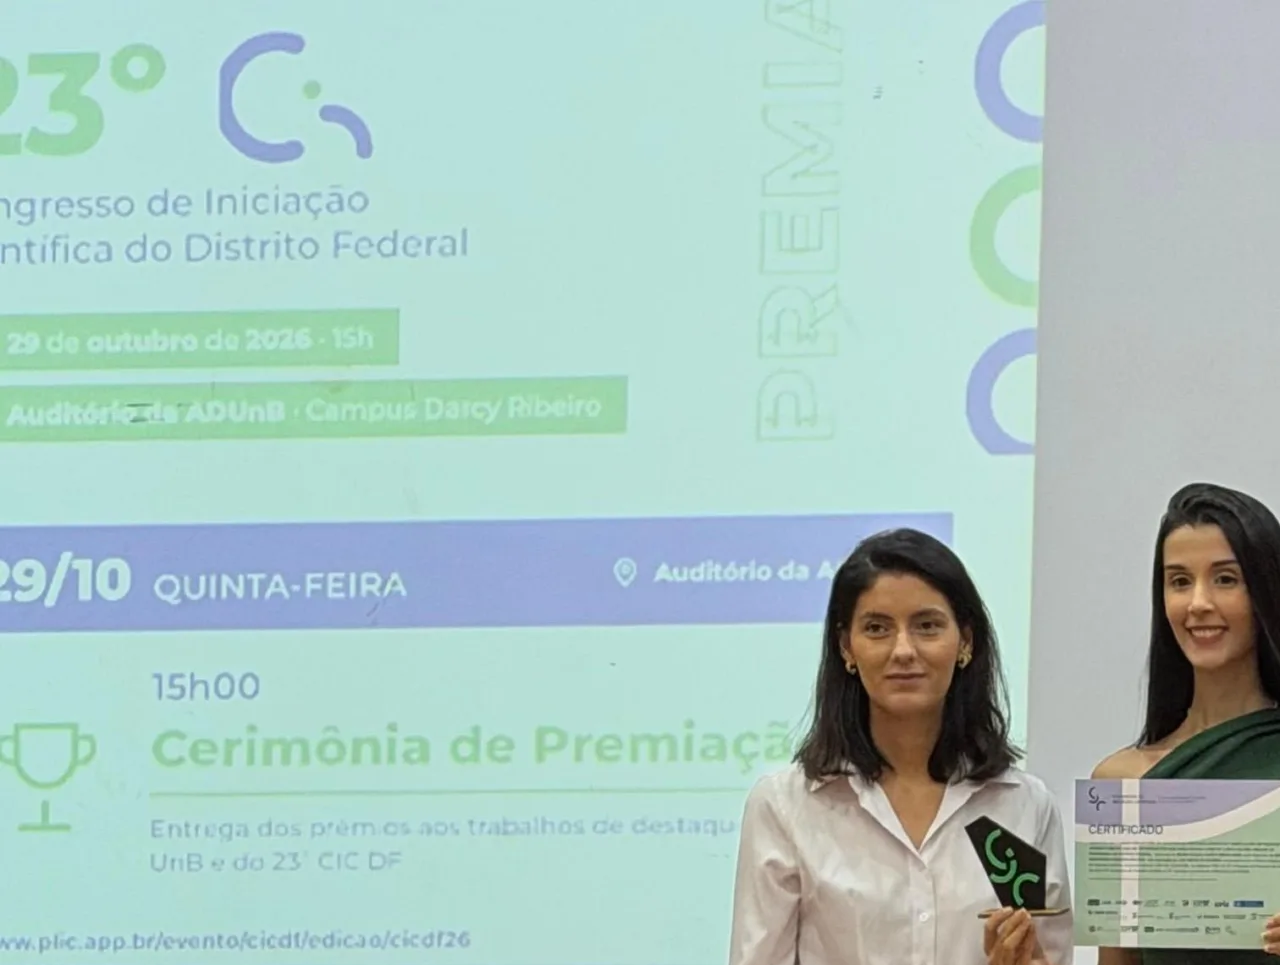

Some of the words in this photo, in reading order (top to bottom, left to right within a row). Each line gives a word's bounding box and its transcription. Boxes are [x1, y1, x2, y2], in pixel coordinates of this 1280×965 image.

[147, 188, 193, 217] de
[205, 185, 370, 219] Iniciação
[125, 234, 172, 262] do
[185, 232, 320, 261] Distrito
[333, 228, 468, 259] Federal
[7, 332, 41, 354] 29
[46, 332, 80, 353] de
[87, 329, 198, 353] outubro
[205, 329, 239, 350] de
[245, 328, 312, 350] 2026
[332, 328, 373, 349] 15h
[305, 398, 417, 424] Campus
[425, 397, 503, 424] Darcy
[508, 395, 602, 418] Ribeiro
[154, 572, 407, 605] QUINTA-FEIRA
[653, 559, 772, 582] Auditório
[777, 560, 809, 581] da
[815, 559, 843, 581] A
[152, 672, 260, 701] 15h00
[151, 721, 431, 768] Cerimônia
[450, 725, 515, 765] de
[535, 718, 793, 776] Premiaçã
[150, 818, 249, 842] Entrega
[257, 817, 301, 837] dos
[469, 815, 585, 837] trabalhos
[592, 816, 625, 835] de
[631, 816, 736, 837] destaqu
[1088, 824, 1164, 835] CERTIFICADO
[318, 851, 360, 871] CIC
[368, 851, 403, 871] DF
